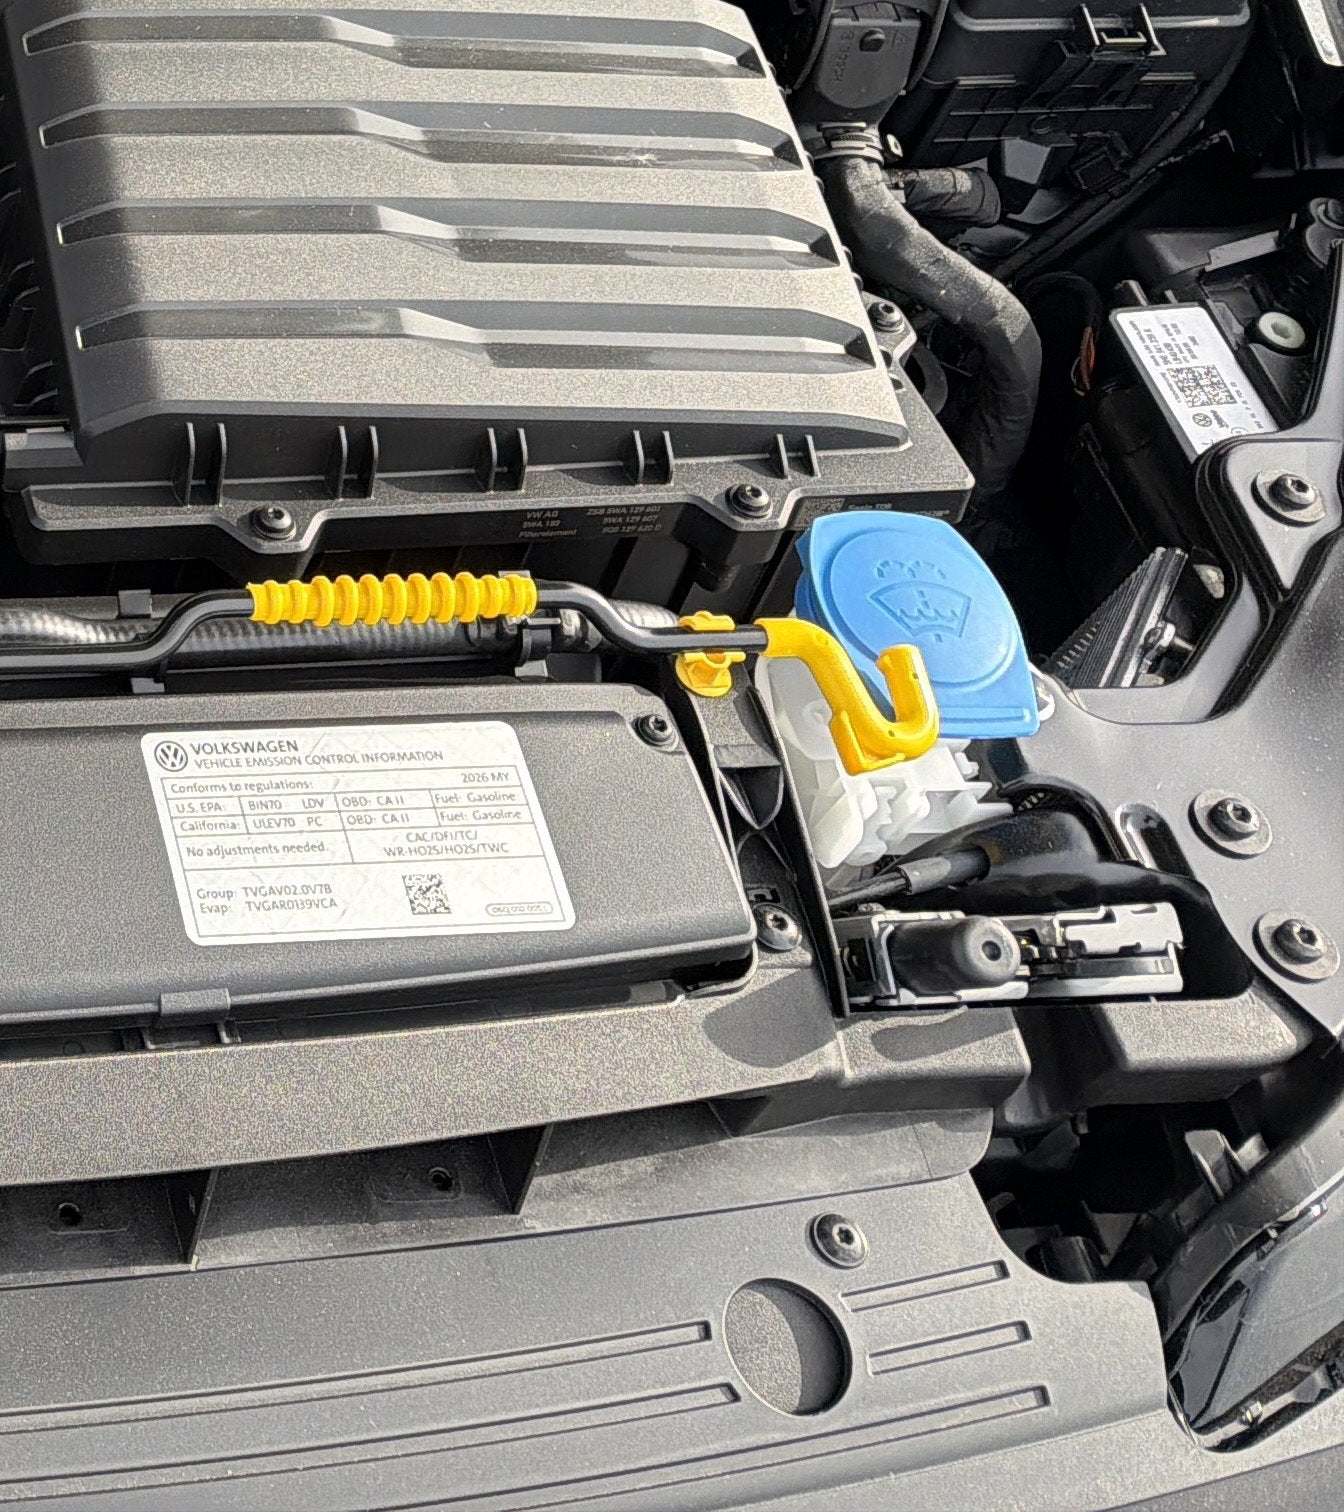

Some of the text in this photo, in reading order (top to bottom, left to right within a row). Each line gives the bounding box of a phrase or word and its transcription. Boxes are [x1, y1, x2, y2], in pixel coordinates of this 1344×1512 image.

[190, 740, 299, 755] VOLKSWAGEN
[194, 751, 443, 769] VEHICLE EMISSION CONTROL INFORMATION
[461, 772, 509, 783] 2026 MY
[170, 779, 313, 794] Conforms to regulations:
[248, 798, 324, 811] BIN70 LDV
[180, 820, 240, 832] California:
[253, 816, 323, 829] ULEV70 PC
[186, 841, 328, 858] No adjustments needed.
